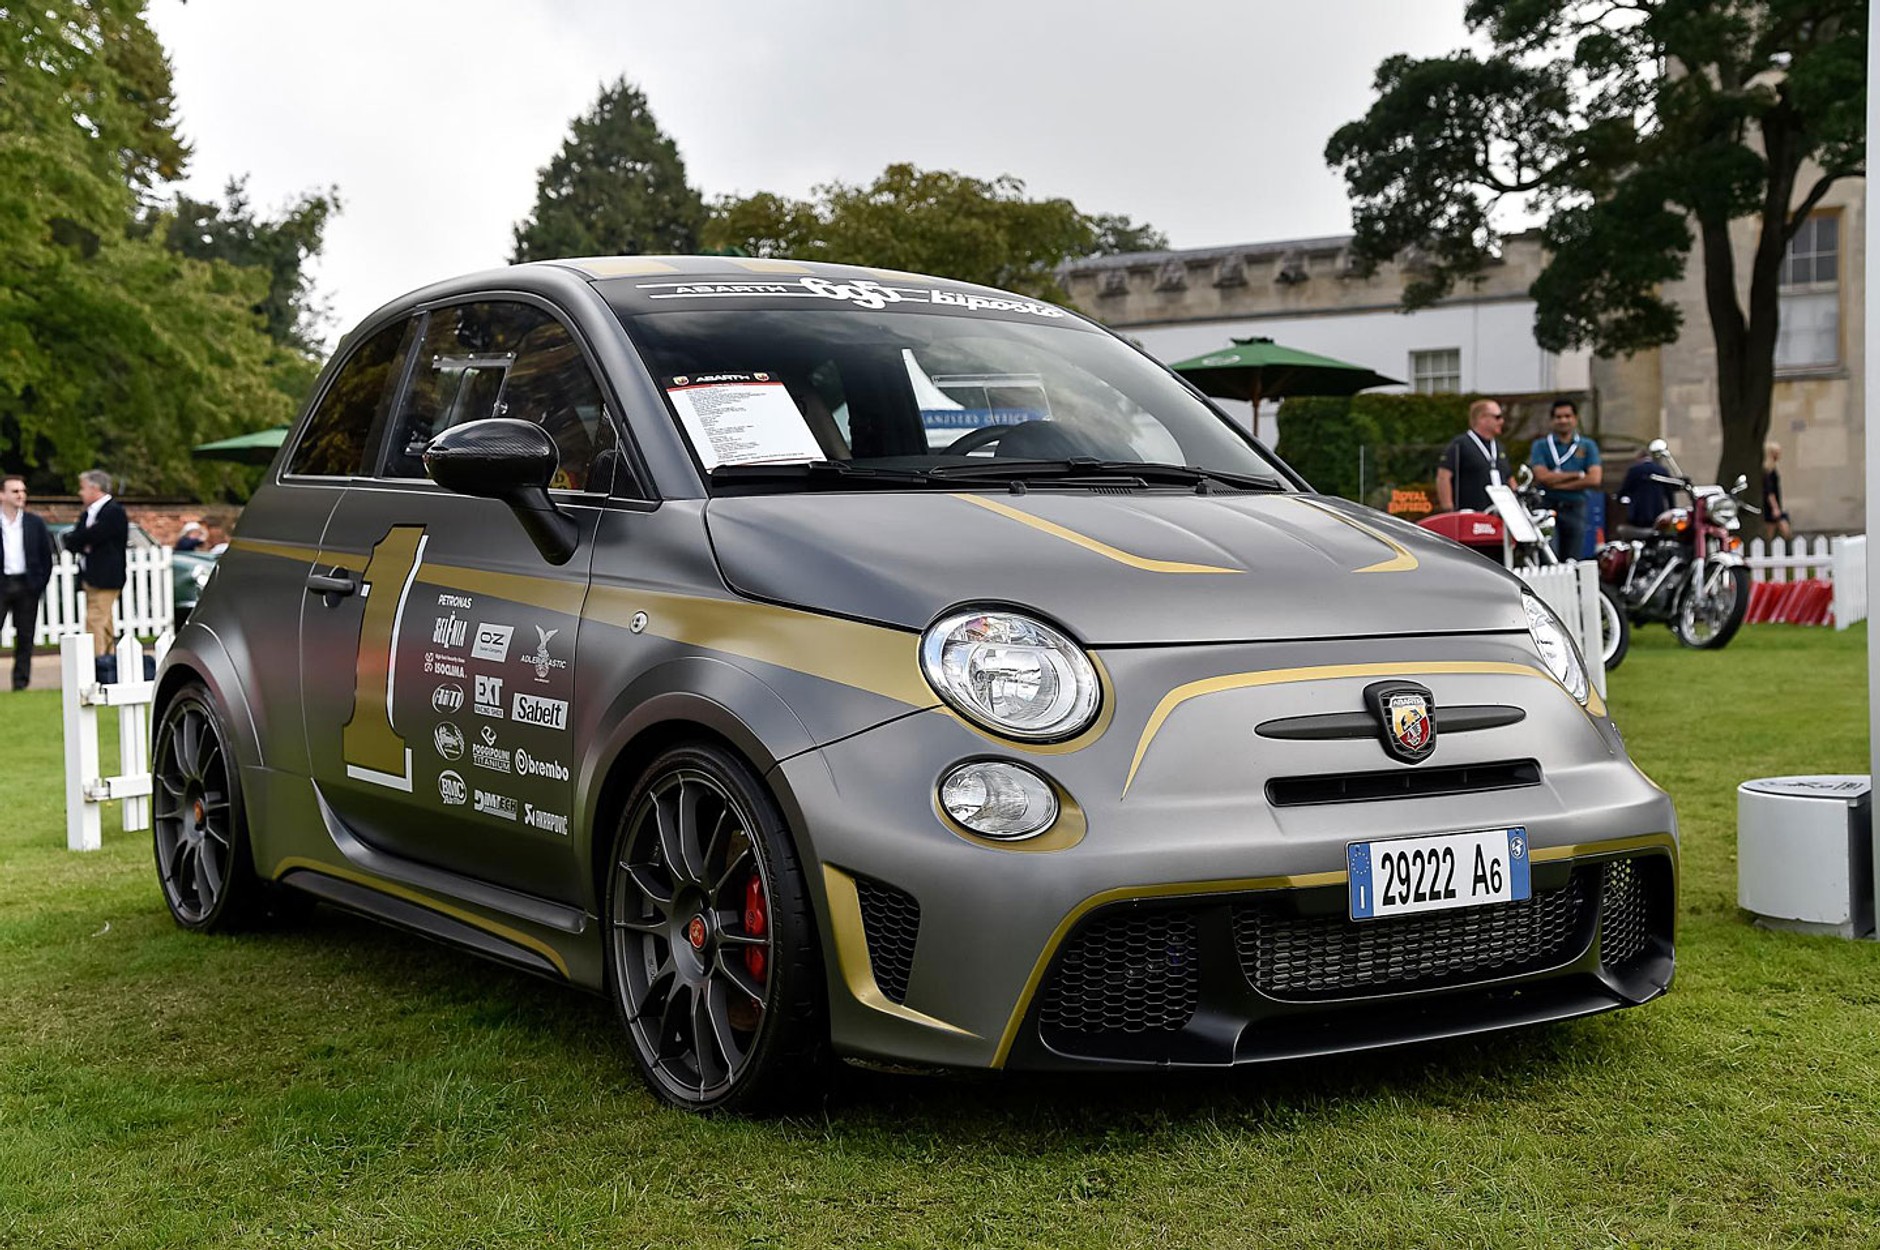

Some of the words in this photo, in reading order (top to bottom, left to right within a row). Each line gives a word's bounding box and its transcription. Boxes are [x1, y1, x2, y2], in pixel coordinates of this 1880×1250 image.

[676, 285, 787, 295] ABARTH
[931, 289, 1064, 318] biposto
[696, 374, 750, 382] ABARTH
[1391, 490, 1427, 501] ROYAL
[438, 594, 473, 609] PETRONAS
[480, 631, 505, 646] OZ
[343, 524, 428, 792] 1
[475, 674, 503, 706] EXT
[518, 696, 561, 726] Sabelt
[528, 754, 569, 781] brembo
[441, 778, 465, 799] BMC
[1381, 846, 1457, 906] 29222
[1471, 843, 1502, 896] A6
